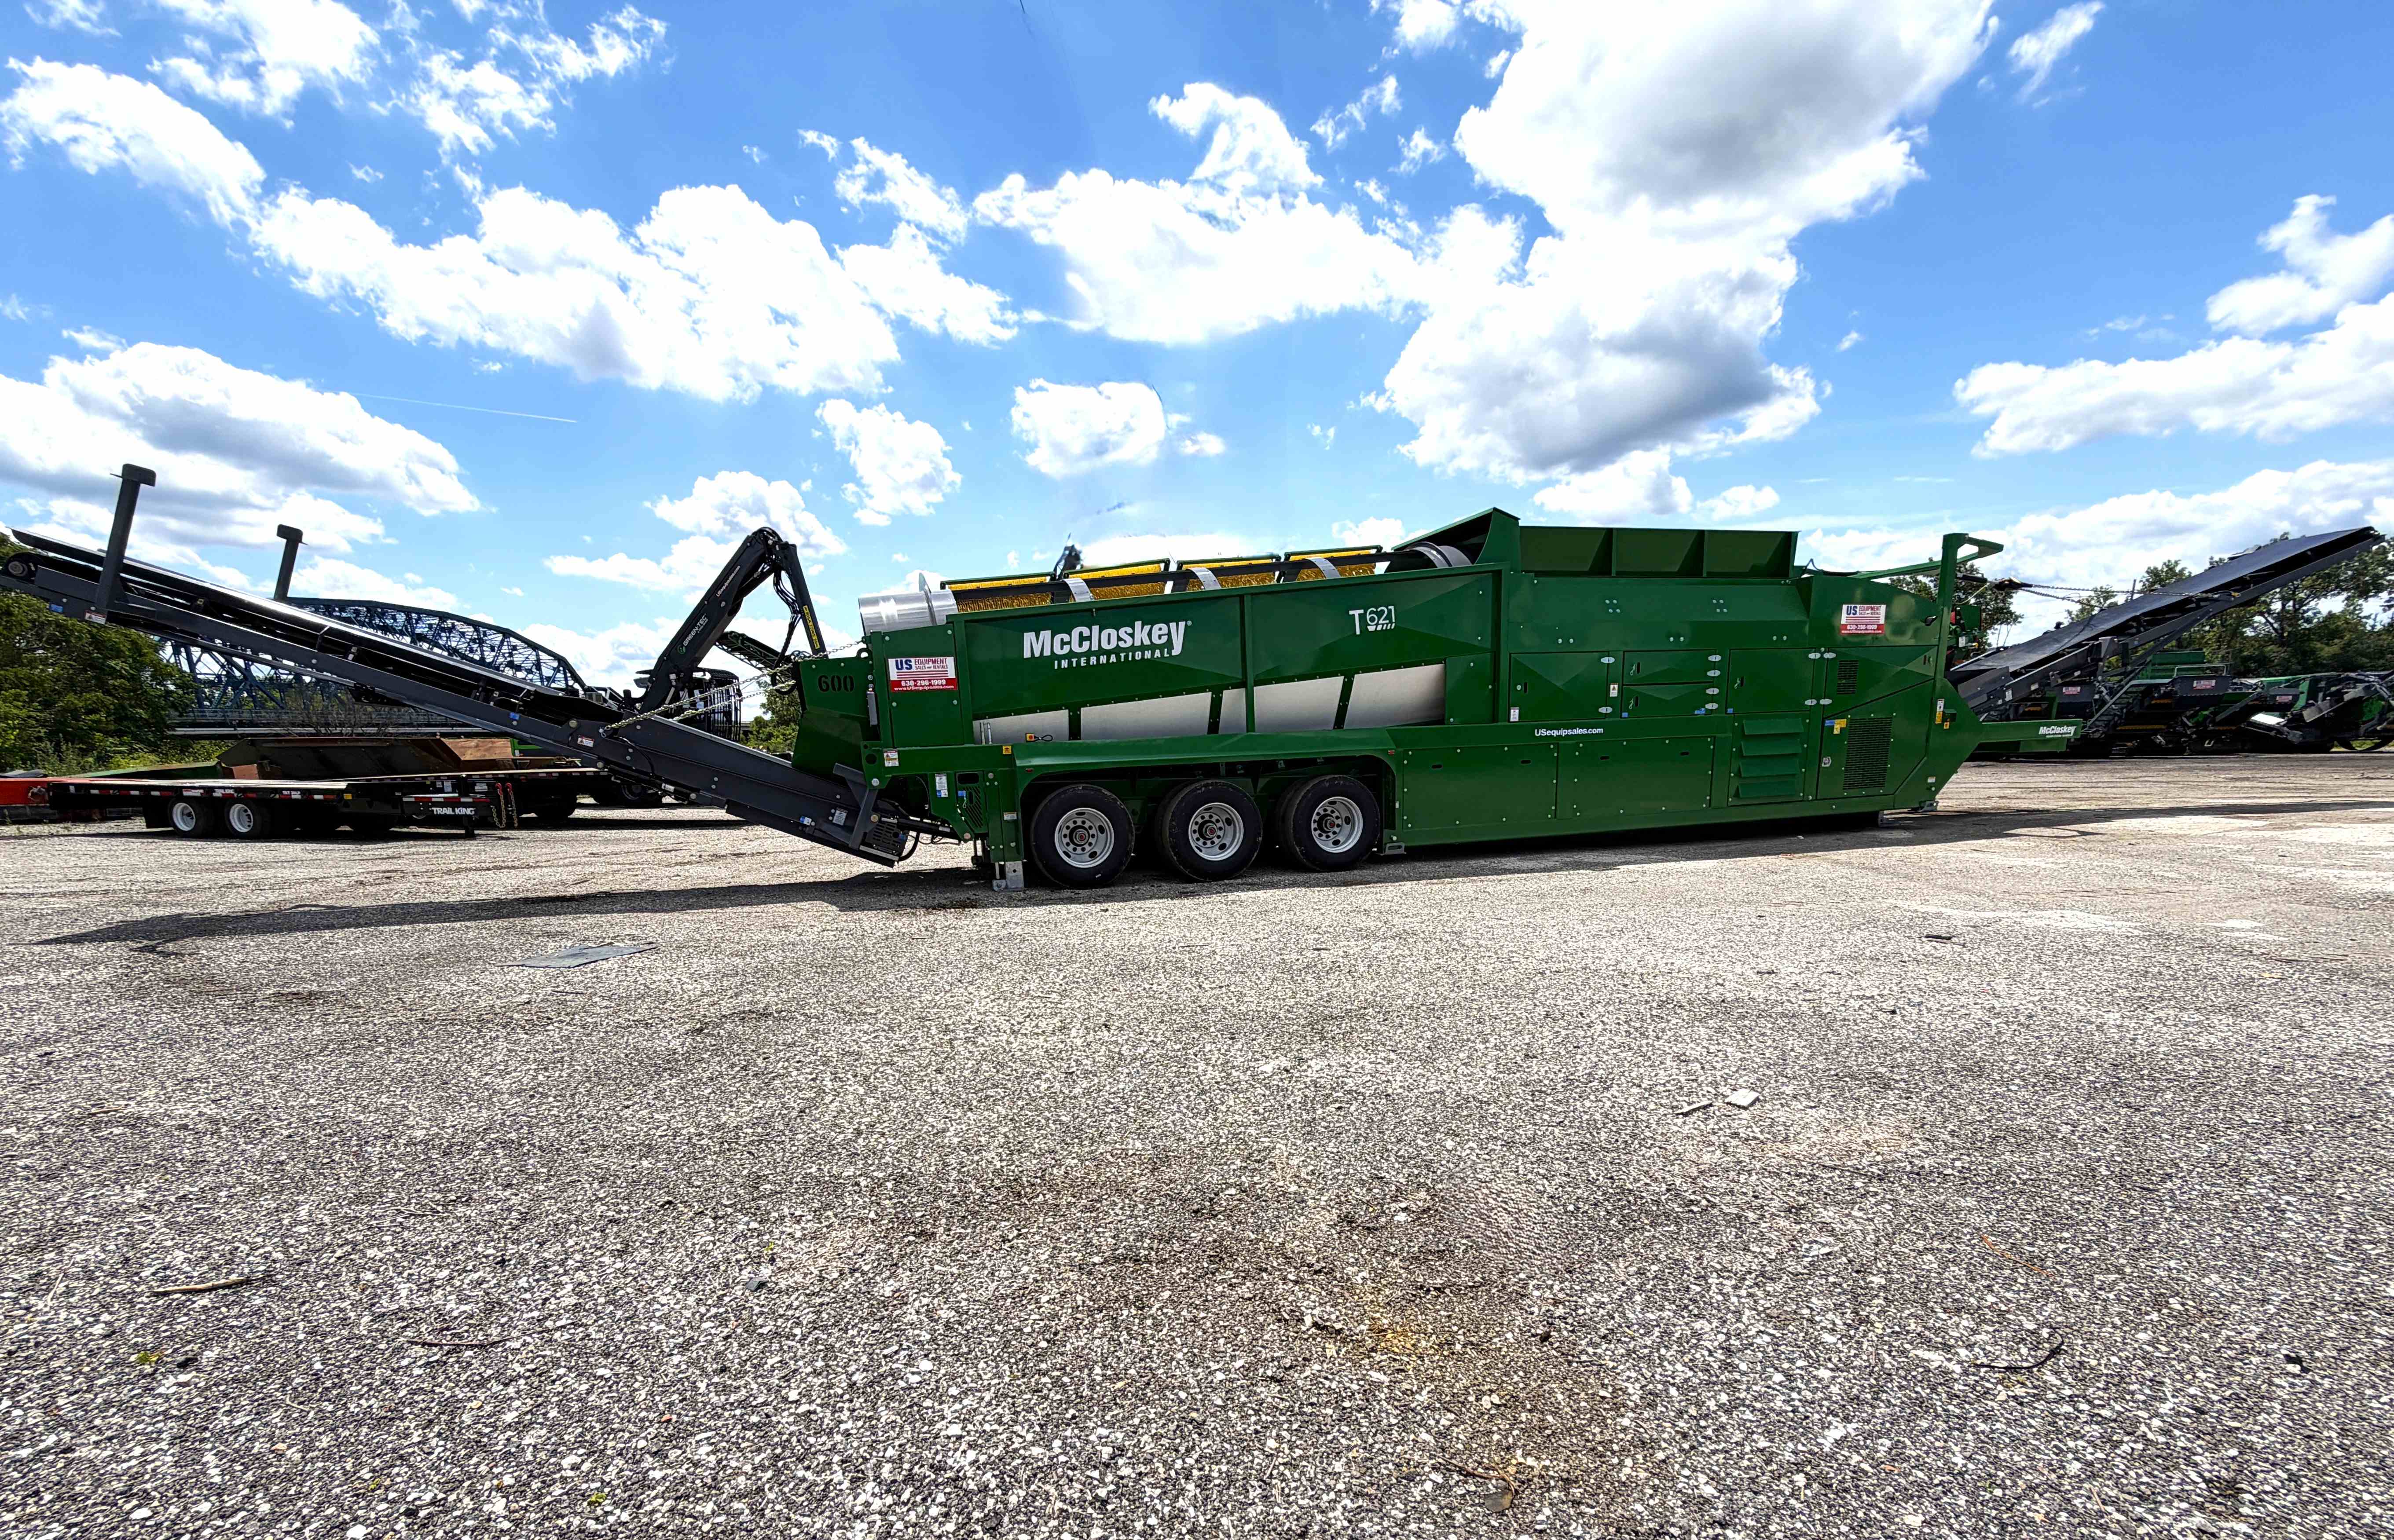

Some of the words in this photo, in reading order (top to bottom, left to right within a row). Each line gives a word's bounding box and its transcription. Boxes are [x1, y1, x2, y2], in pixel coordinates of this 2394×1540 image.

[1847, 606, 1858, 615] US
[1023, 621, 1185, 658] McCloskey
[1055, 648, 1169, 669] INTERNATIONAL
[895, 659, 913, 670] US
[818, 675, 854, 692] 600
[1535, 728, 1604, 737] USequipsales.com
[2038, 725, 2077, 736] McCloskey
